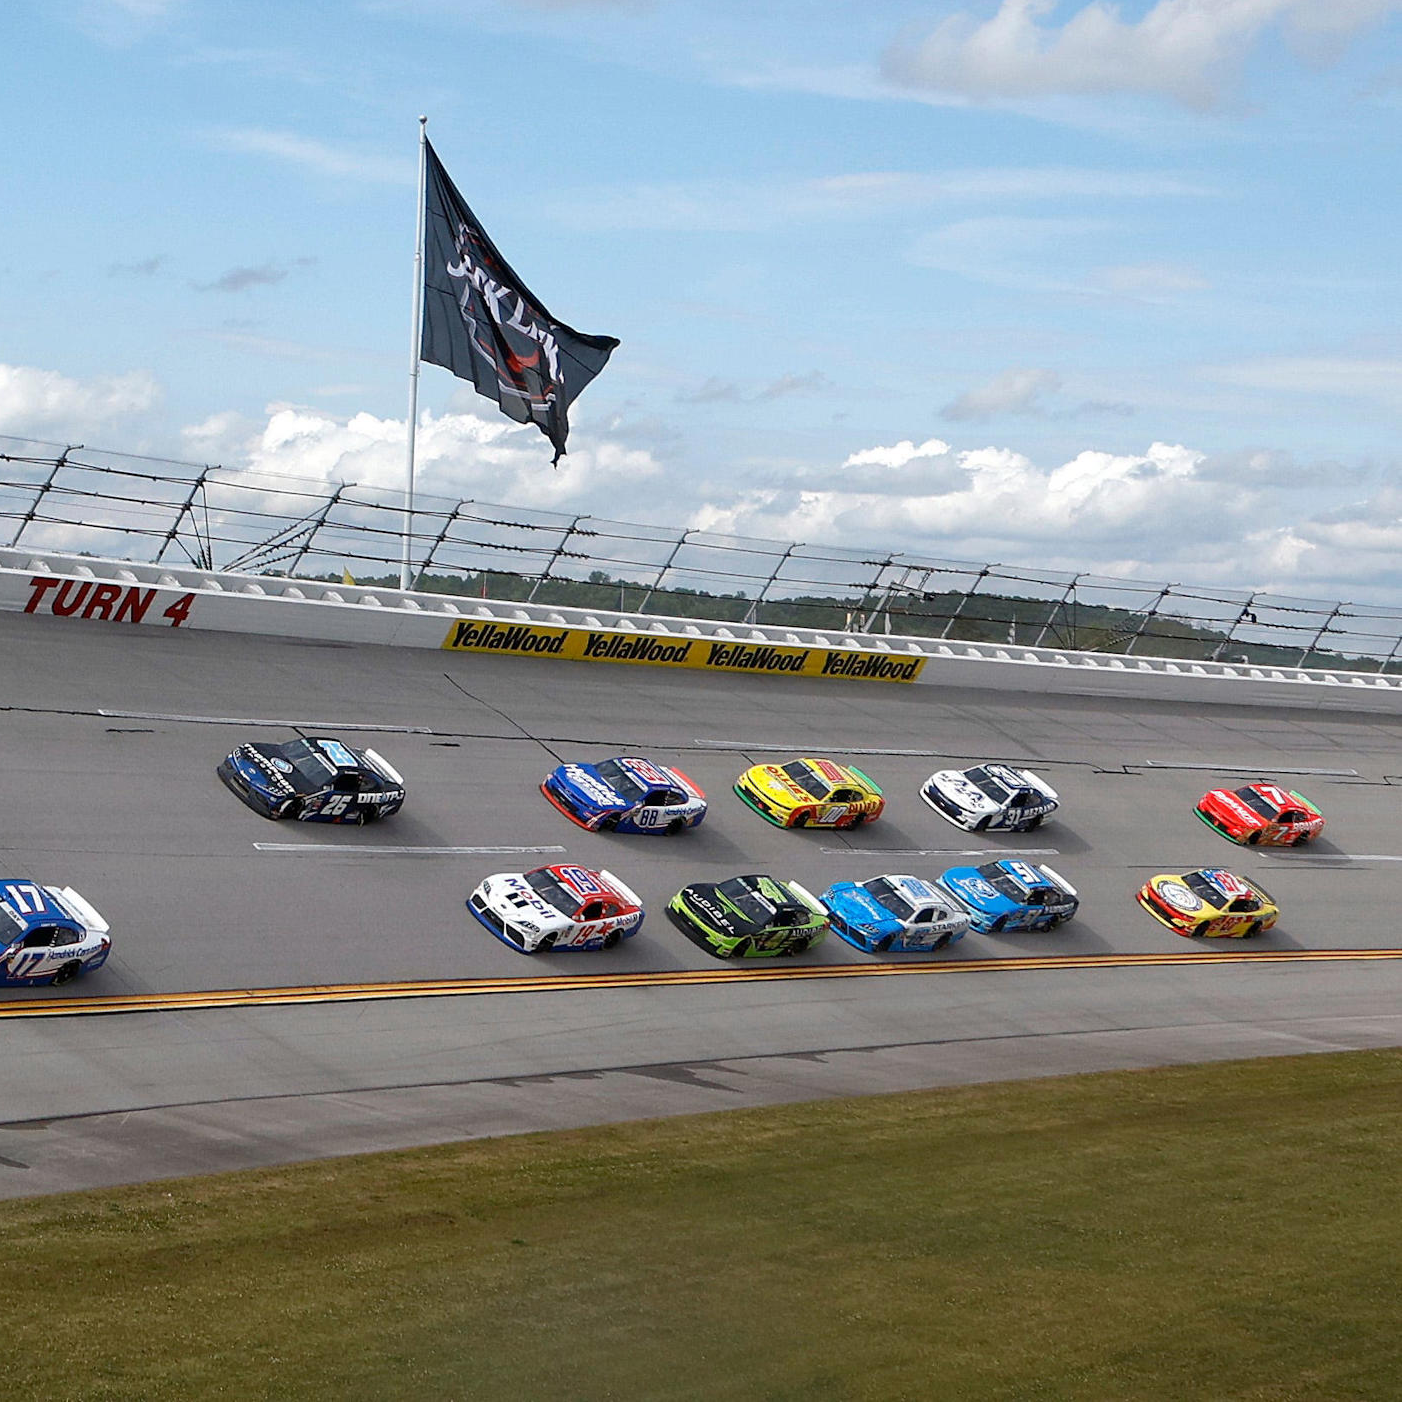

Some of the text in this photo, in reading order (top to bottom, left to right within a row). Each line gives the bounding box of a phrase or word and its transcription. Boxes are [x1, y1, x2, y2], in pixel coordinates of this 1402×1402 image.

[24, 576, 196, 627] TURN 4
[451, 622, 567, 654] YellaWood
[583, 633, 692, 664] YellaWood
[706, 643, 809, 672] YellaWood
[821, 652, 917, 681] YellaWood
[320, 794, 353, 816] 26
[1260, 786, 1285, 805] 7
[640, 808, 659, 826] 88
[1004, 808, 1021, 825] 31
[1273, 826, 1289, 841] 7
[560, 867, 599, 894] 19
[5, 884, 47, 915] 17
[504, 877, 557, 919] Mobil
[685, 888, 737, 935] AUDIBEL
[9, 910, 22, 921] DAY
[570, 925, 596, 945] 19
[7, 952, 47, 978] 17
